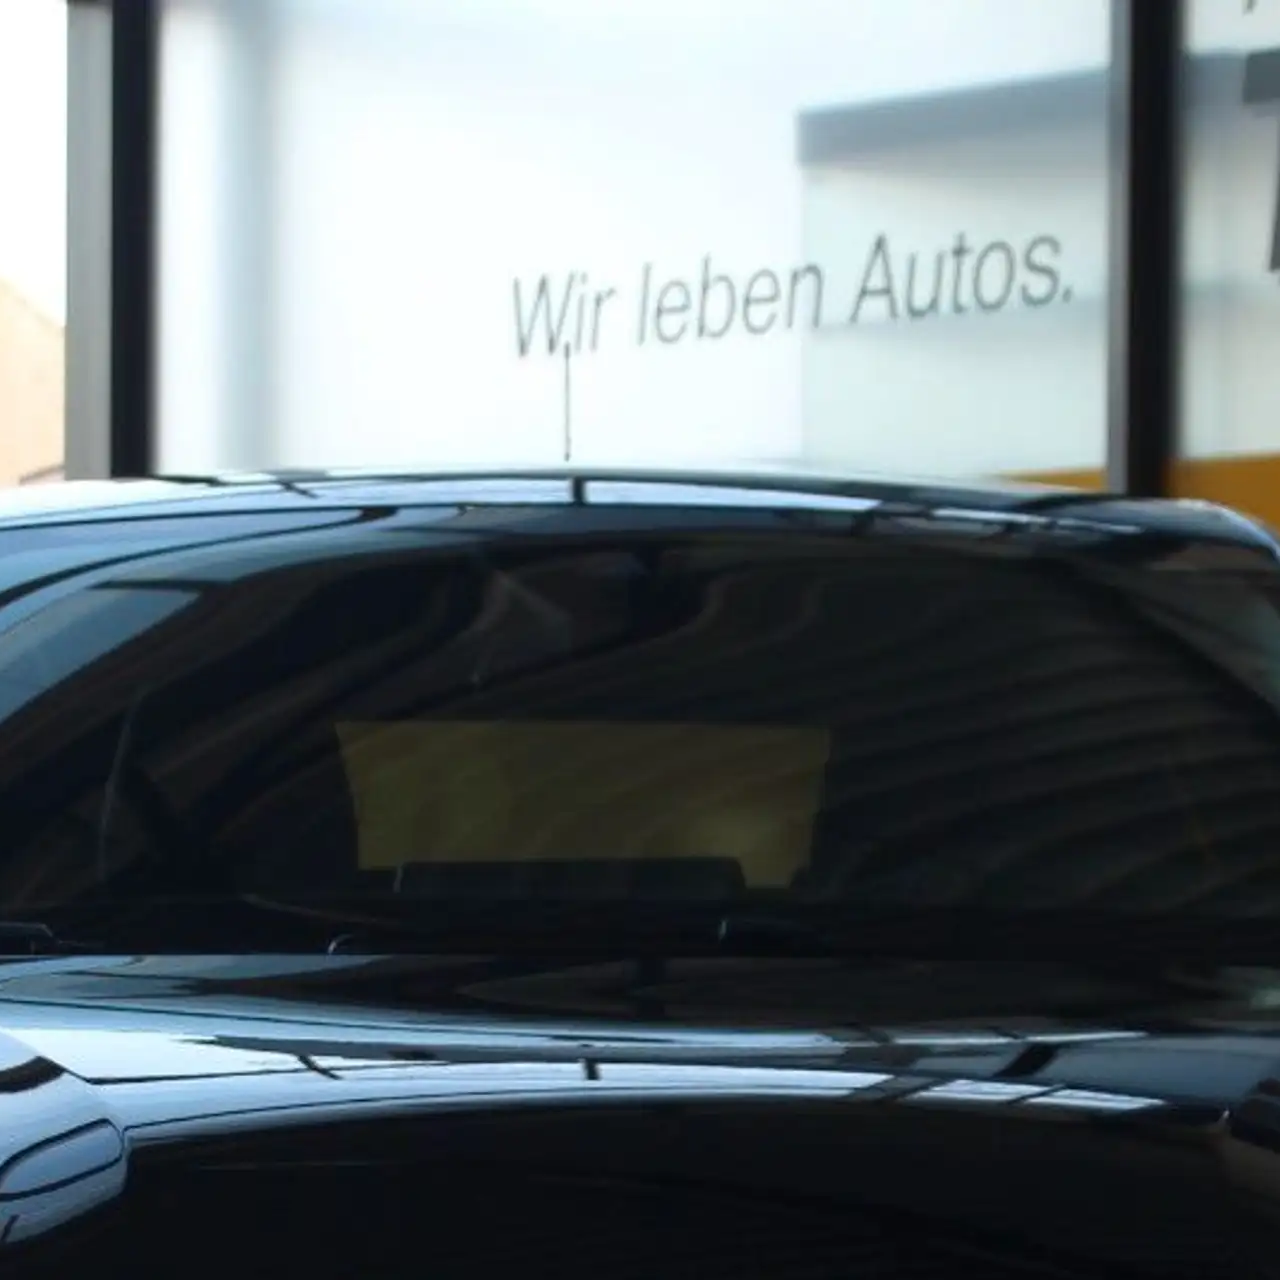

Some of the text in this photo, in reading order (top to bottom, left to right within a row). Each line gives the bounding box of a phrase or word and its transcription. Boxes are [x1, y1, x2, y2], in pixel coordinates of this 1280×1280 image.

[513, 232, 1073, 359] Wir leben Autos.
